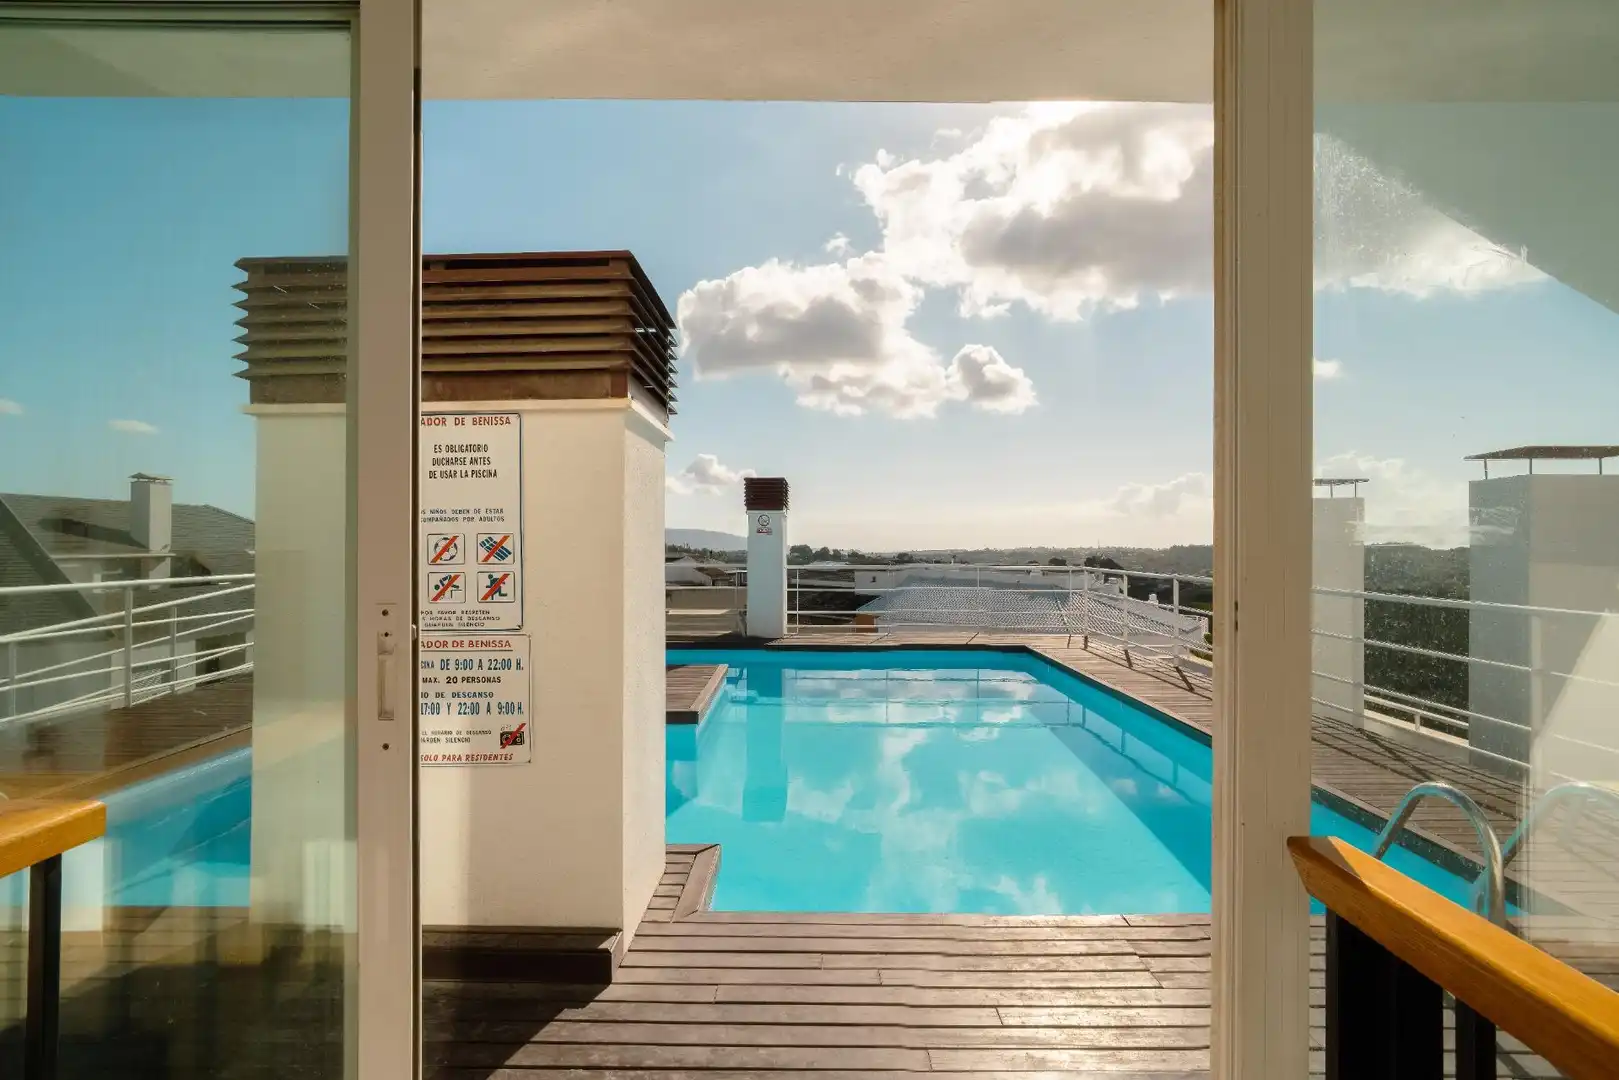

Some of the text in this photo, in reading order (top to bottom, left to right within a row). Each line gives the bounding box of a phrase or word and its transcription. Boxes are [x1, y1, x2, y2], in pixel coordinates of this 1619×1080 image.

[472, 417, 511, 425] BENISSA
[434, 444, 488, 453] ES OBLIGATORIO
[432, 457, 491, 466] DUCHARSE ANTES
[429, 470, 497, 479] DE USAR LA PISCINA
[440, 659, 450, 670] DE
[455, 659, 473, 670] 9:00
[478, 659, 482, 670] A
[488, 659, 511, 670] 22:00
[516, 659, 523, 670] H.
[447, 702, 451, 715] Y
[458, 702, 479, 715] 22:00
[487, 702, 491, 715] A
[498, 702, 514, 714] 9:00
[518, 702, 523, 714] H.
